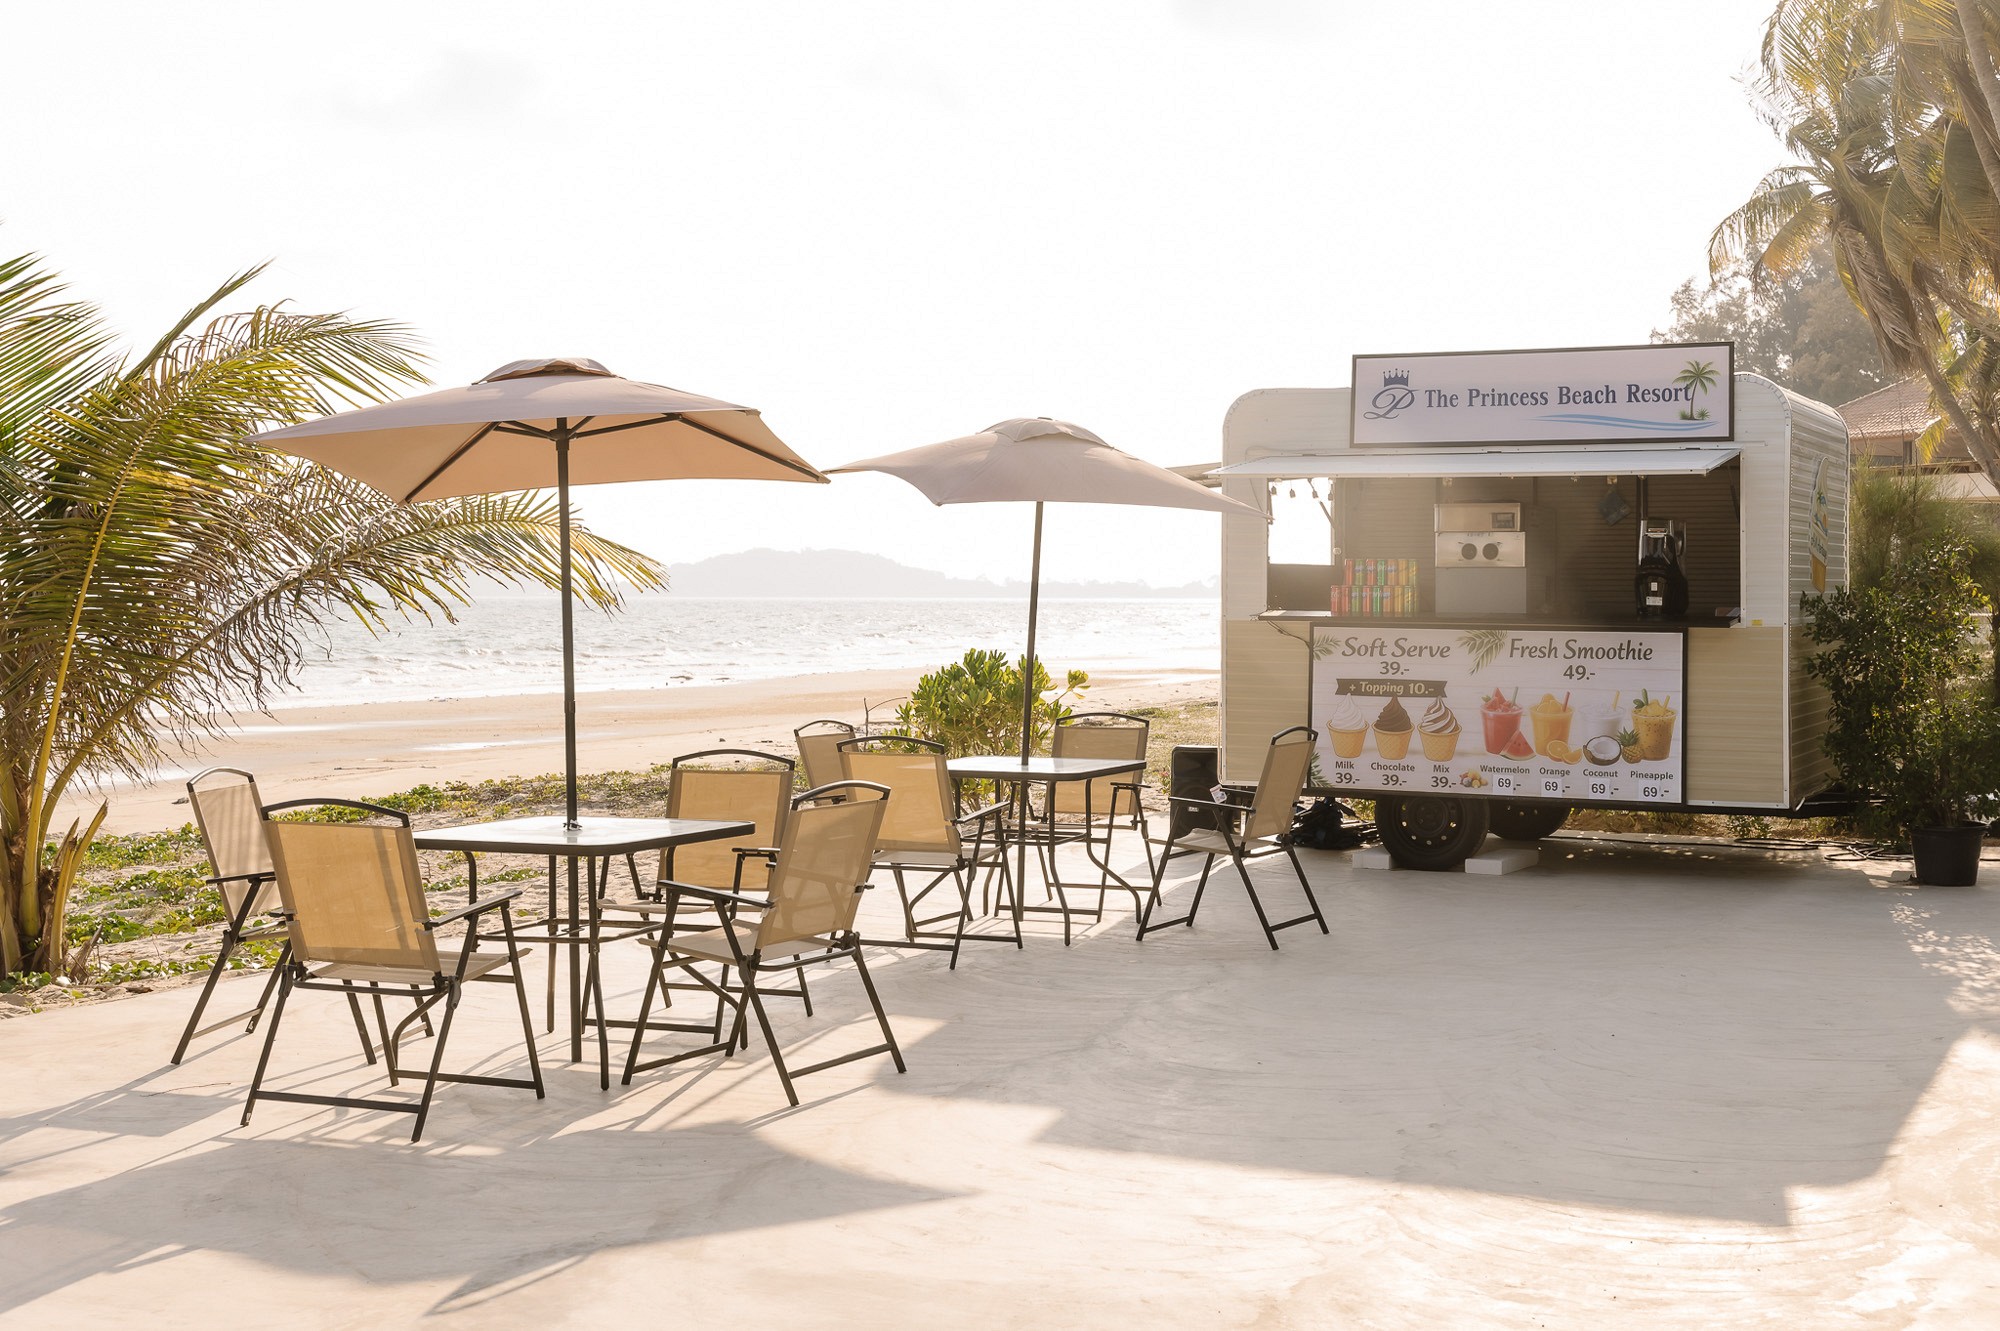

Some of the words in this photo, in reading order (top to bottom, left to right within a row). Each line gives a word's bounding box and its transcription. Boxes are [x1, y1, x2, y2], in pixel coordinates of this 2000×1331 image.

[1425, 389, 1459, 408] The
[1467, 388, 1549, 407] Princess
[1558, 385, 1617, 405] Beach
[1626, 384, 1693, 403] Resort
[1341, 637, 1388, 657] Soft
[1391, 637, 1451, 658] Serve
[1509, 638, 1558, 659] Fresh
[1563, 639, 1653, 660] Smoothie
[1379, 661, 1410, 675] 39.-
[1563, 665, 1596, 680] 49.-
[1360, 681, 1404, 695] Topping
[1408, 683, 1435, 694] 10.-
[1335, 761, 1355, 769] Milk
[1370, 762, 1415, 772] Chocolate
[1433, 765, 1449, 773] Mix
[1480, 765, 1530, 774] Watermelon
[1539, 767, 1570, 777] Orange
[1583, 769, 1618, 778] Coconut
[1630, 771, 1674, 780] Pineapple
[1335, 773, 1360, 784] 39.-
[1382, 774, 1407, 786] 39.-
[1431, 776, 1456, 788] 39.-
